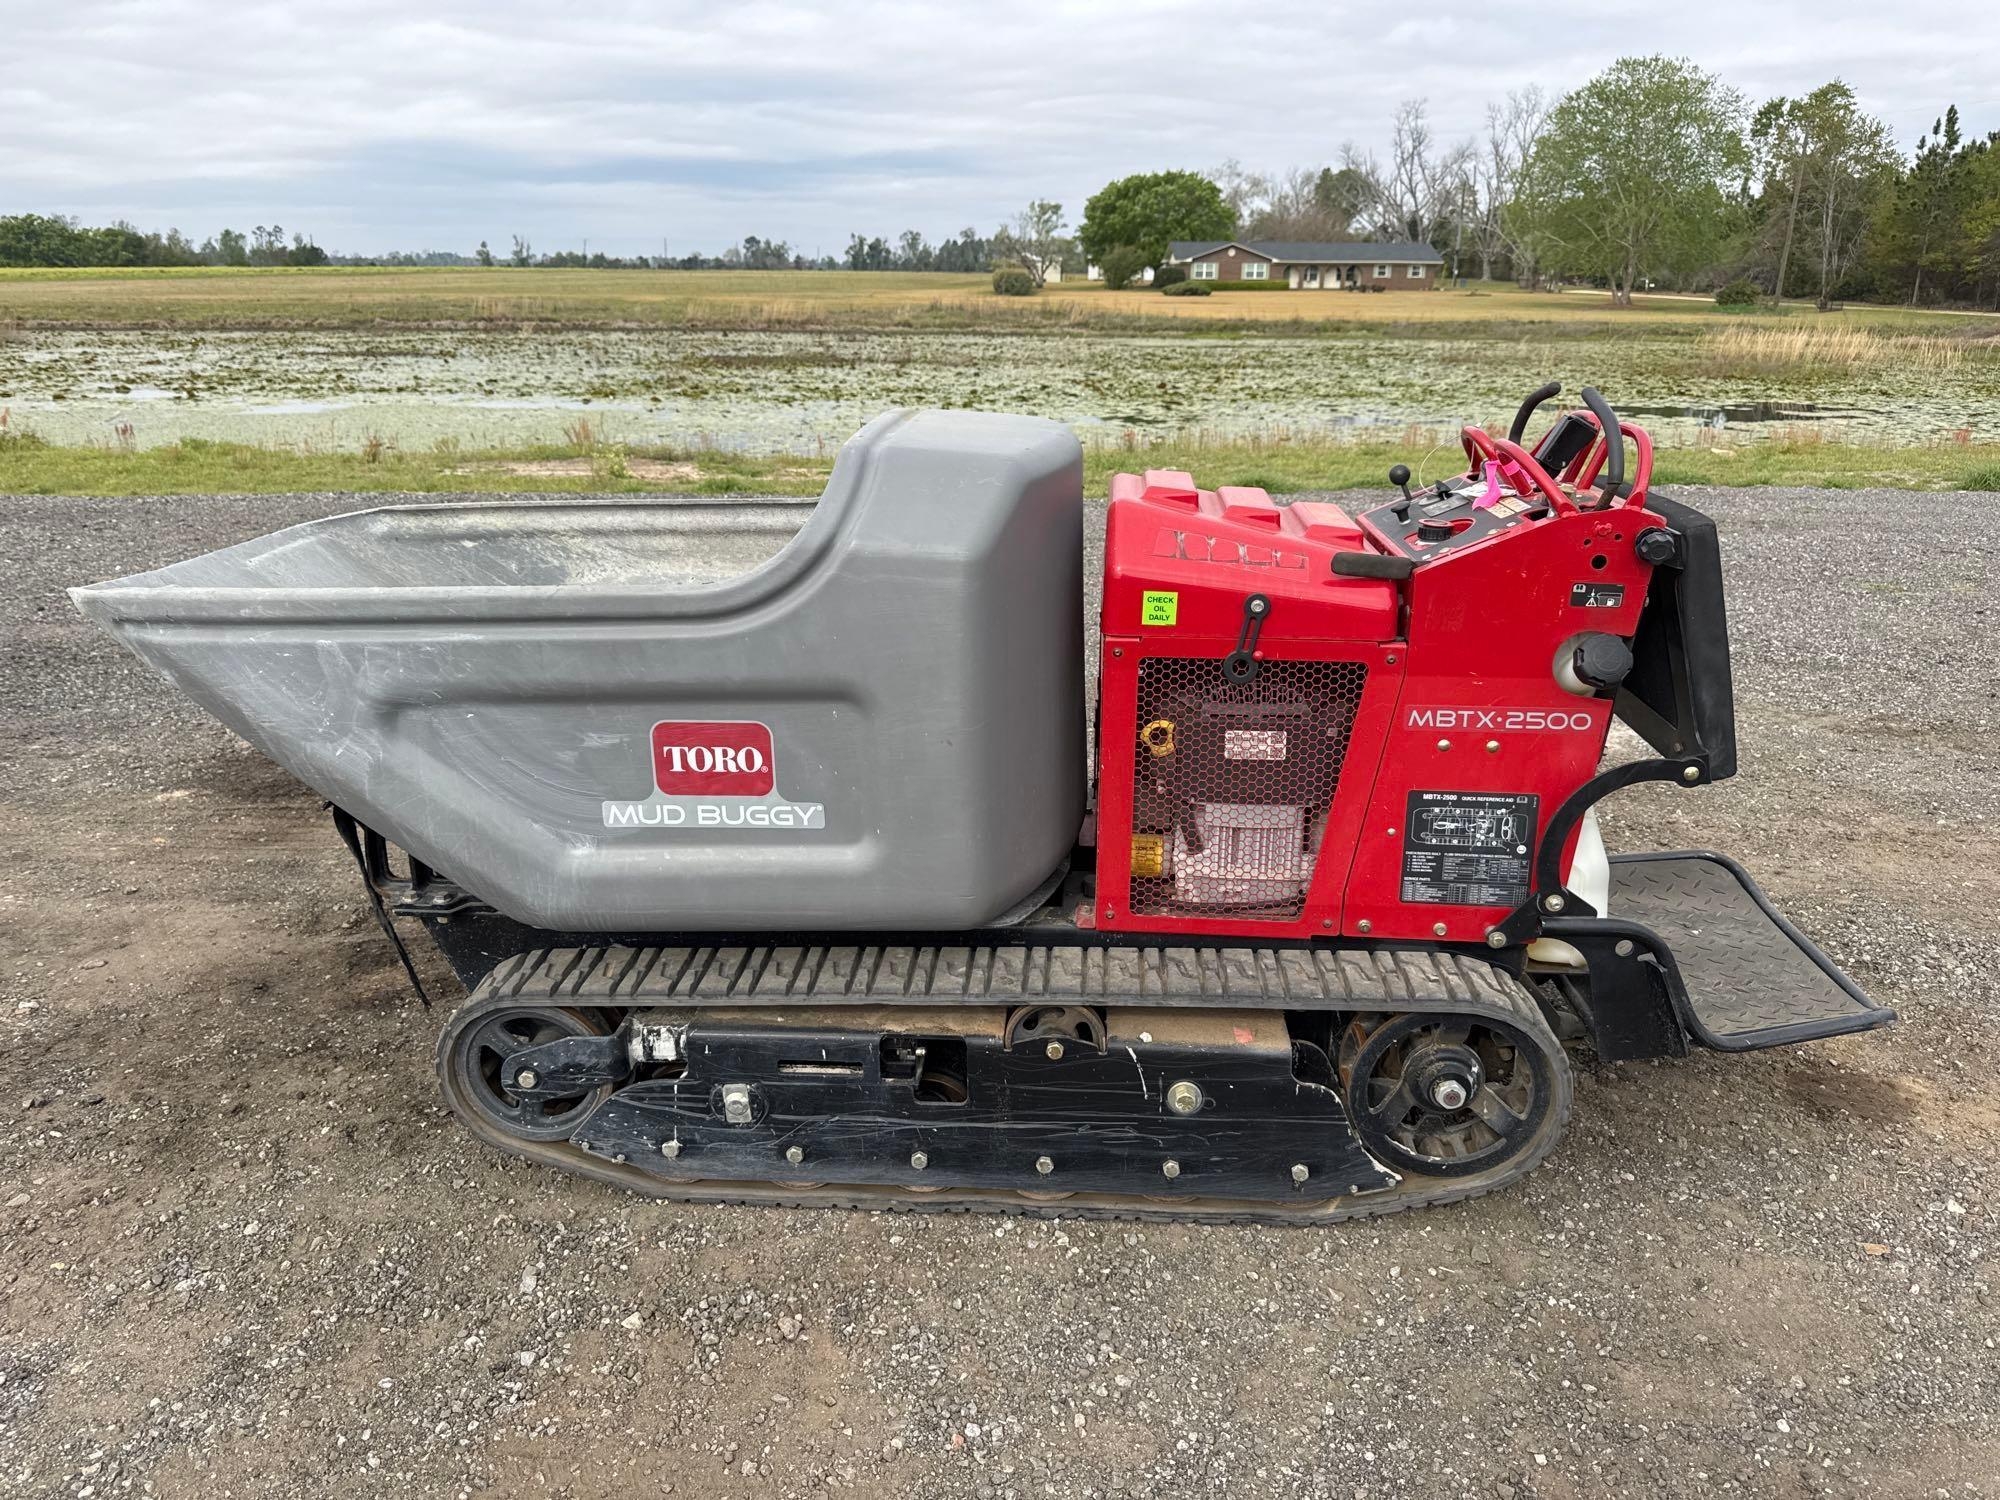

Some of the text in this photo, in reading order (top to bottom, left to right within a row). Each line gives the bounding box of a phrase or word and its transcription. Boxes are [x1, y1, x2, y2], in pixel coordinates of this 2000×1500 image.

[1147, 596, 1174, 604] CHECK
[1422, 793, 1458, 801] MBTX-2500
[608, 804, 818, 826] MUD BUGGY
